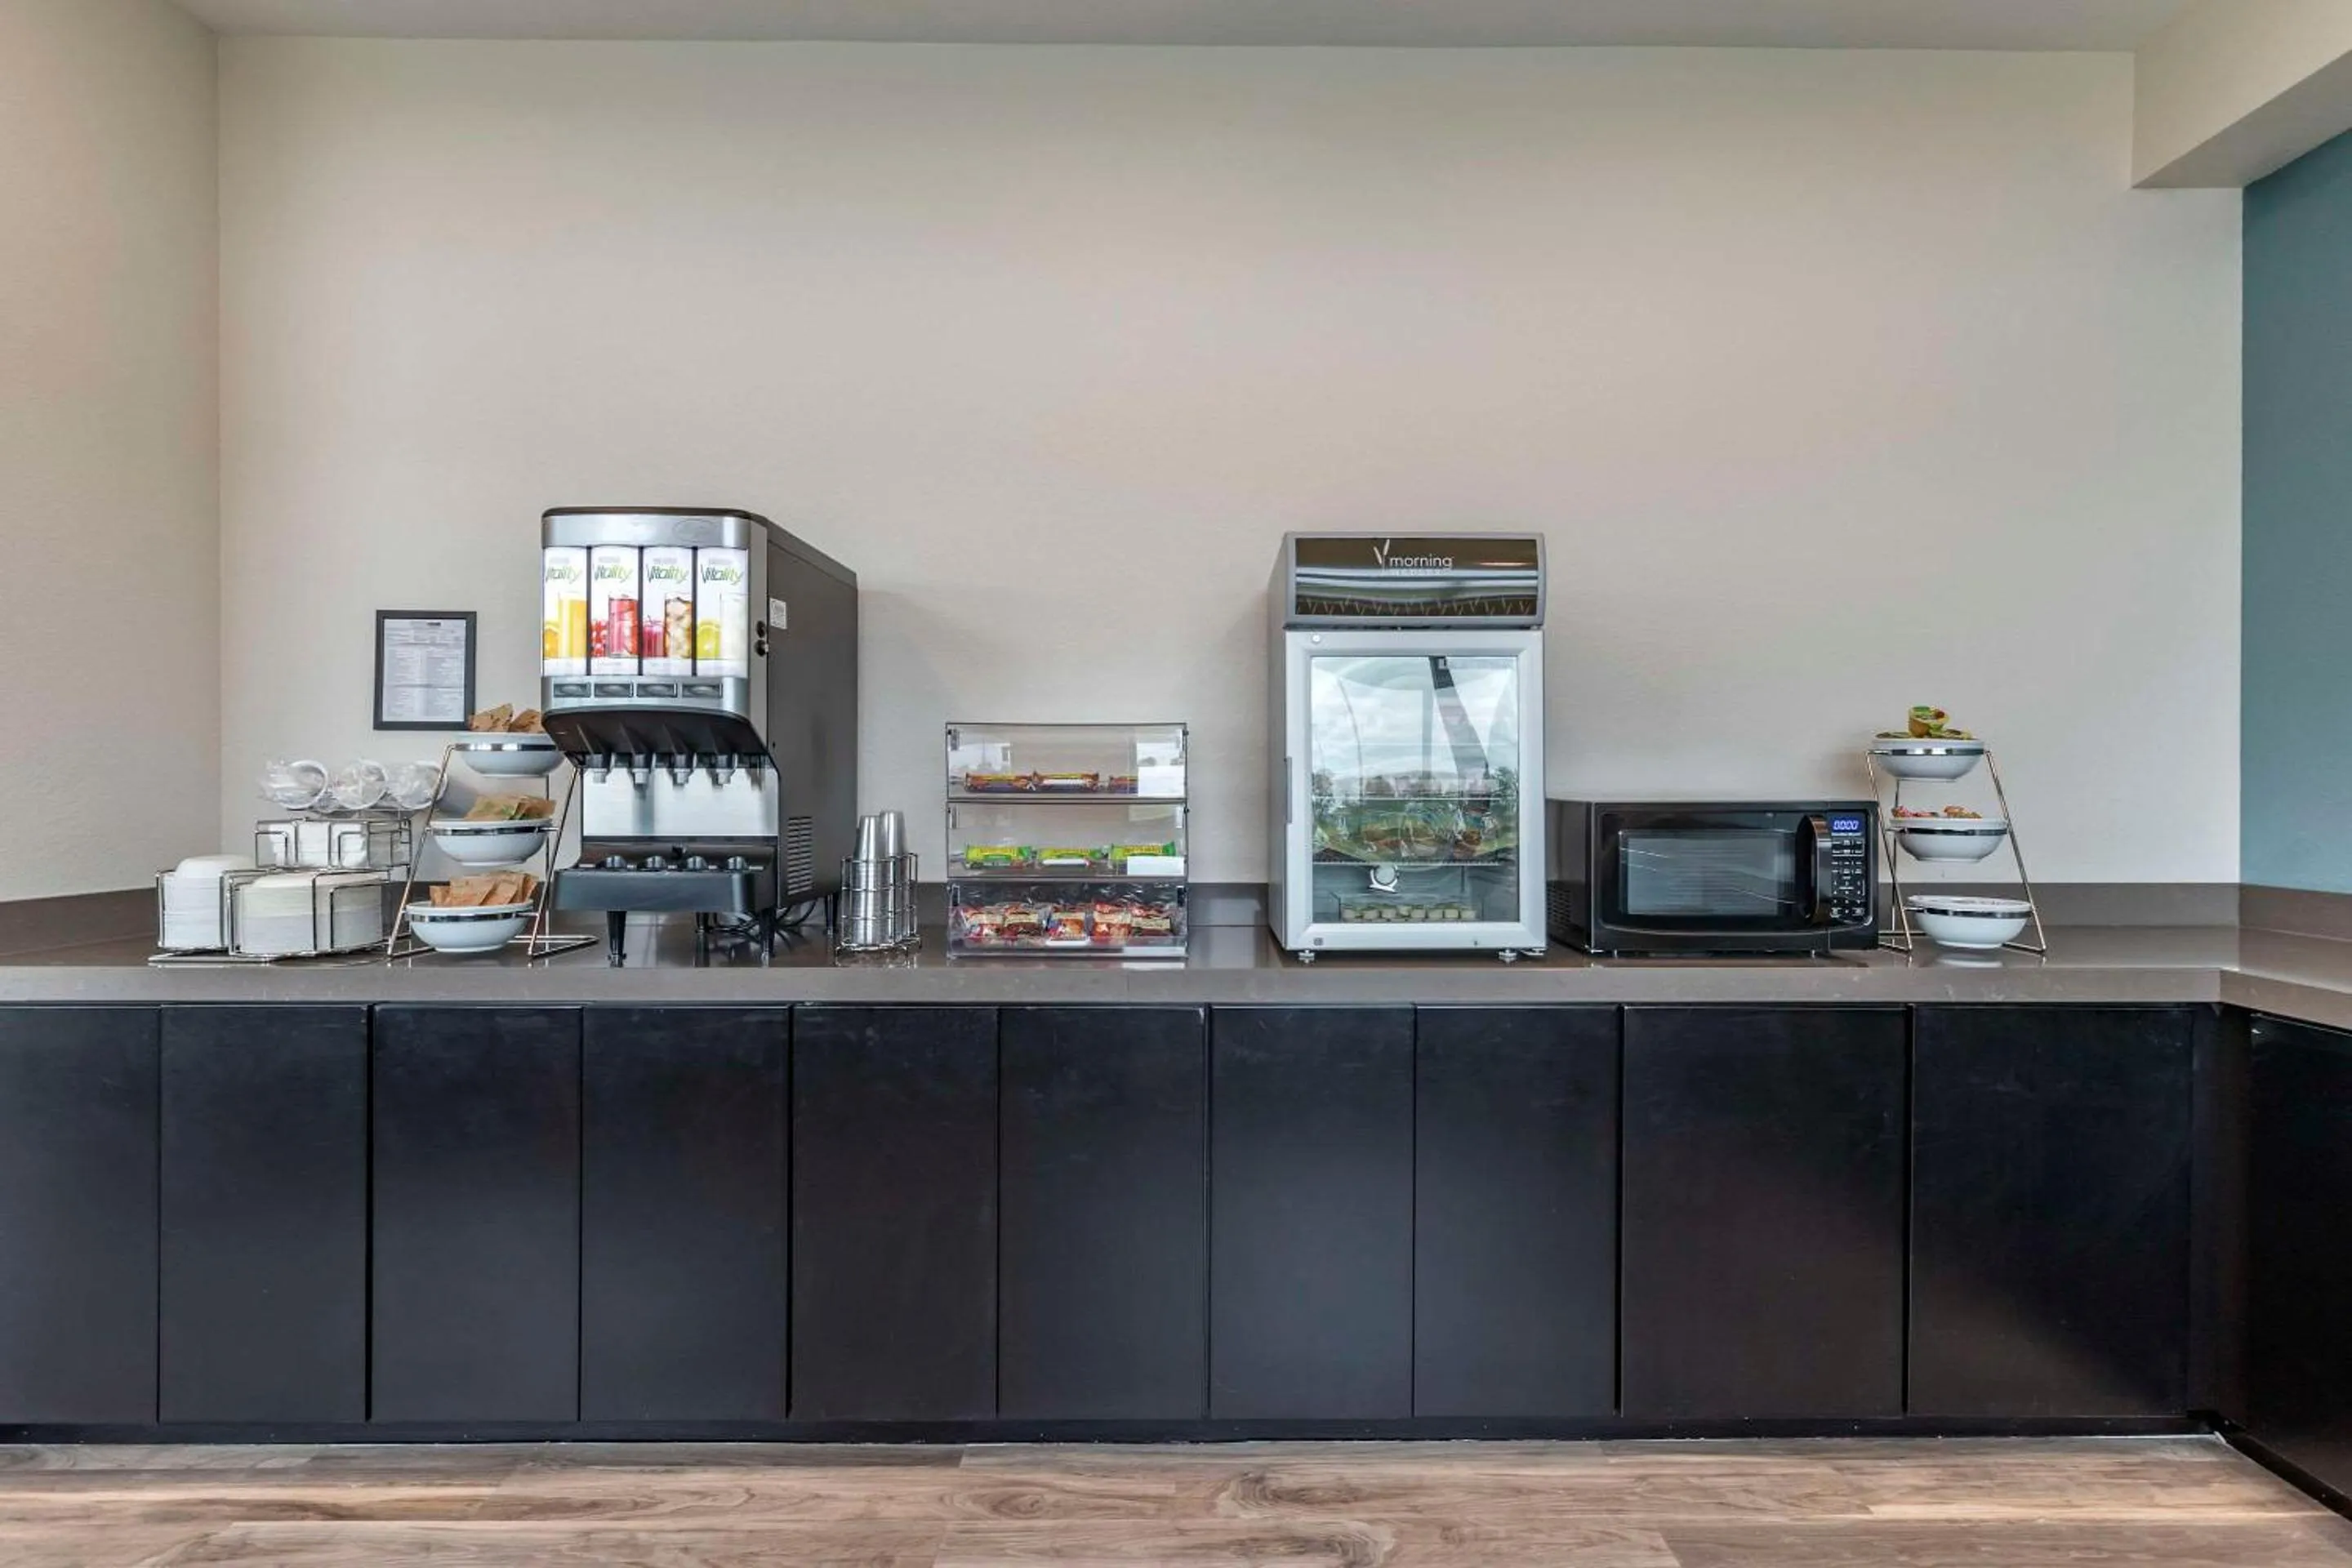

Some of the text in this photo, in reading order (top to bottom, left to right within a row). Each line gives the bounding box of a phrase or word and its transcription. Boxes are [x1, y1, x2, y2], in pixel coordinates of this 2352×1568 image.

[1390, 554, 1454, 571] morning
[646, 564, 689, 585] Vitality
[701, 564, 743, 586] Vitality
